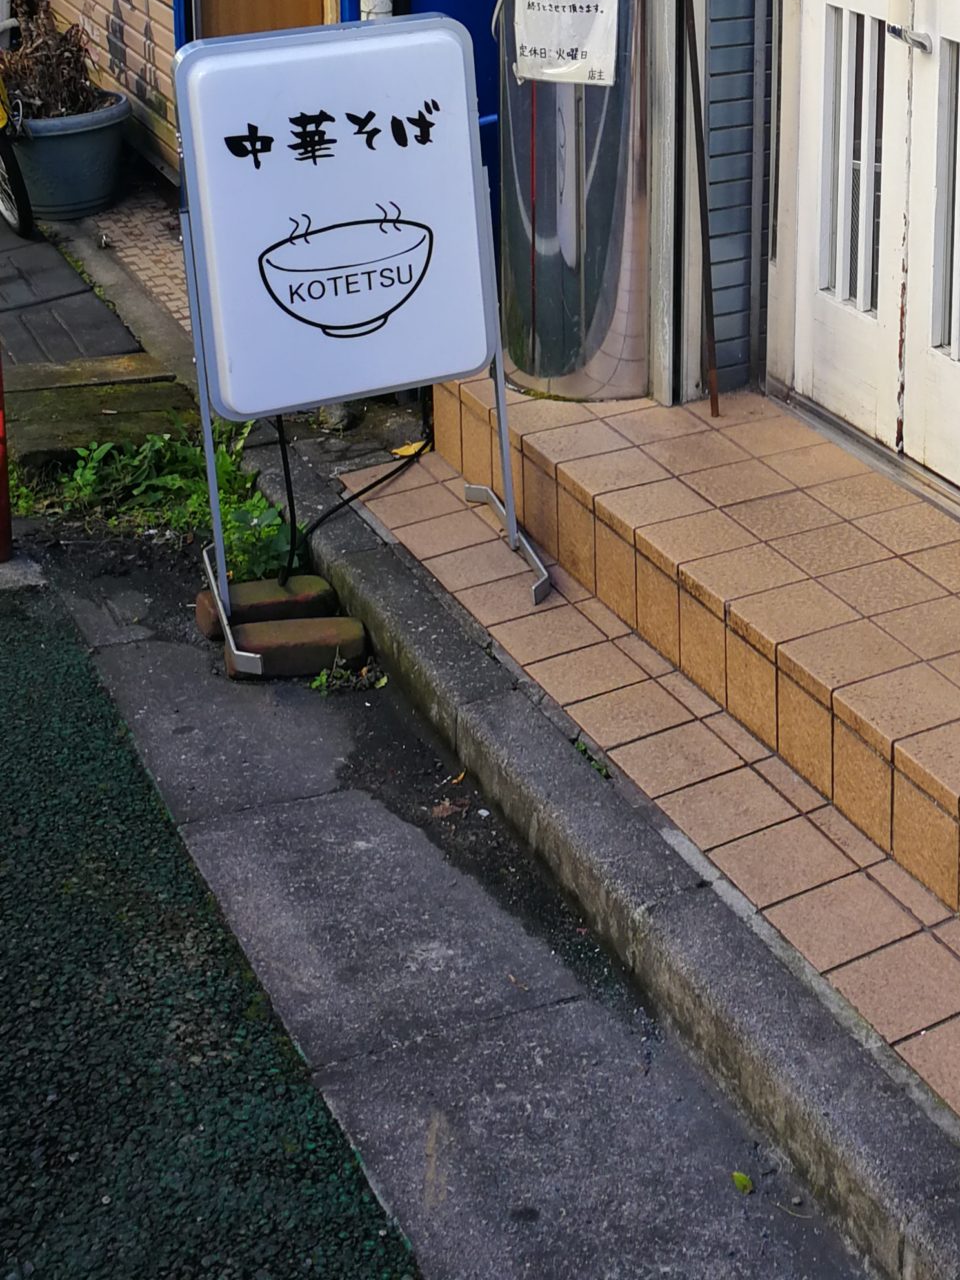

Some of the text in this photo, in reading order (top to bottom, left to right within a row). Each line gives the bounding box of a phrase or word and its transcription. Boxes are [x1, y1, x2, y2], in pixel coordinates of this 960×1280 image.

[587, 68, 605, 81] 店主
[224, 99, 440, 170] 中華そば
[288, 263, 414, 305] KOTETSU
